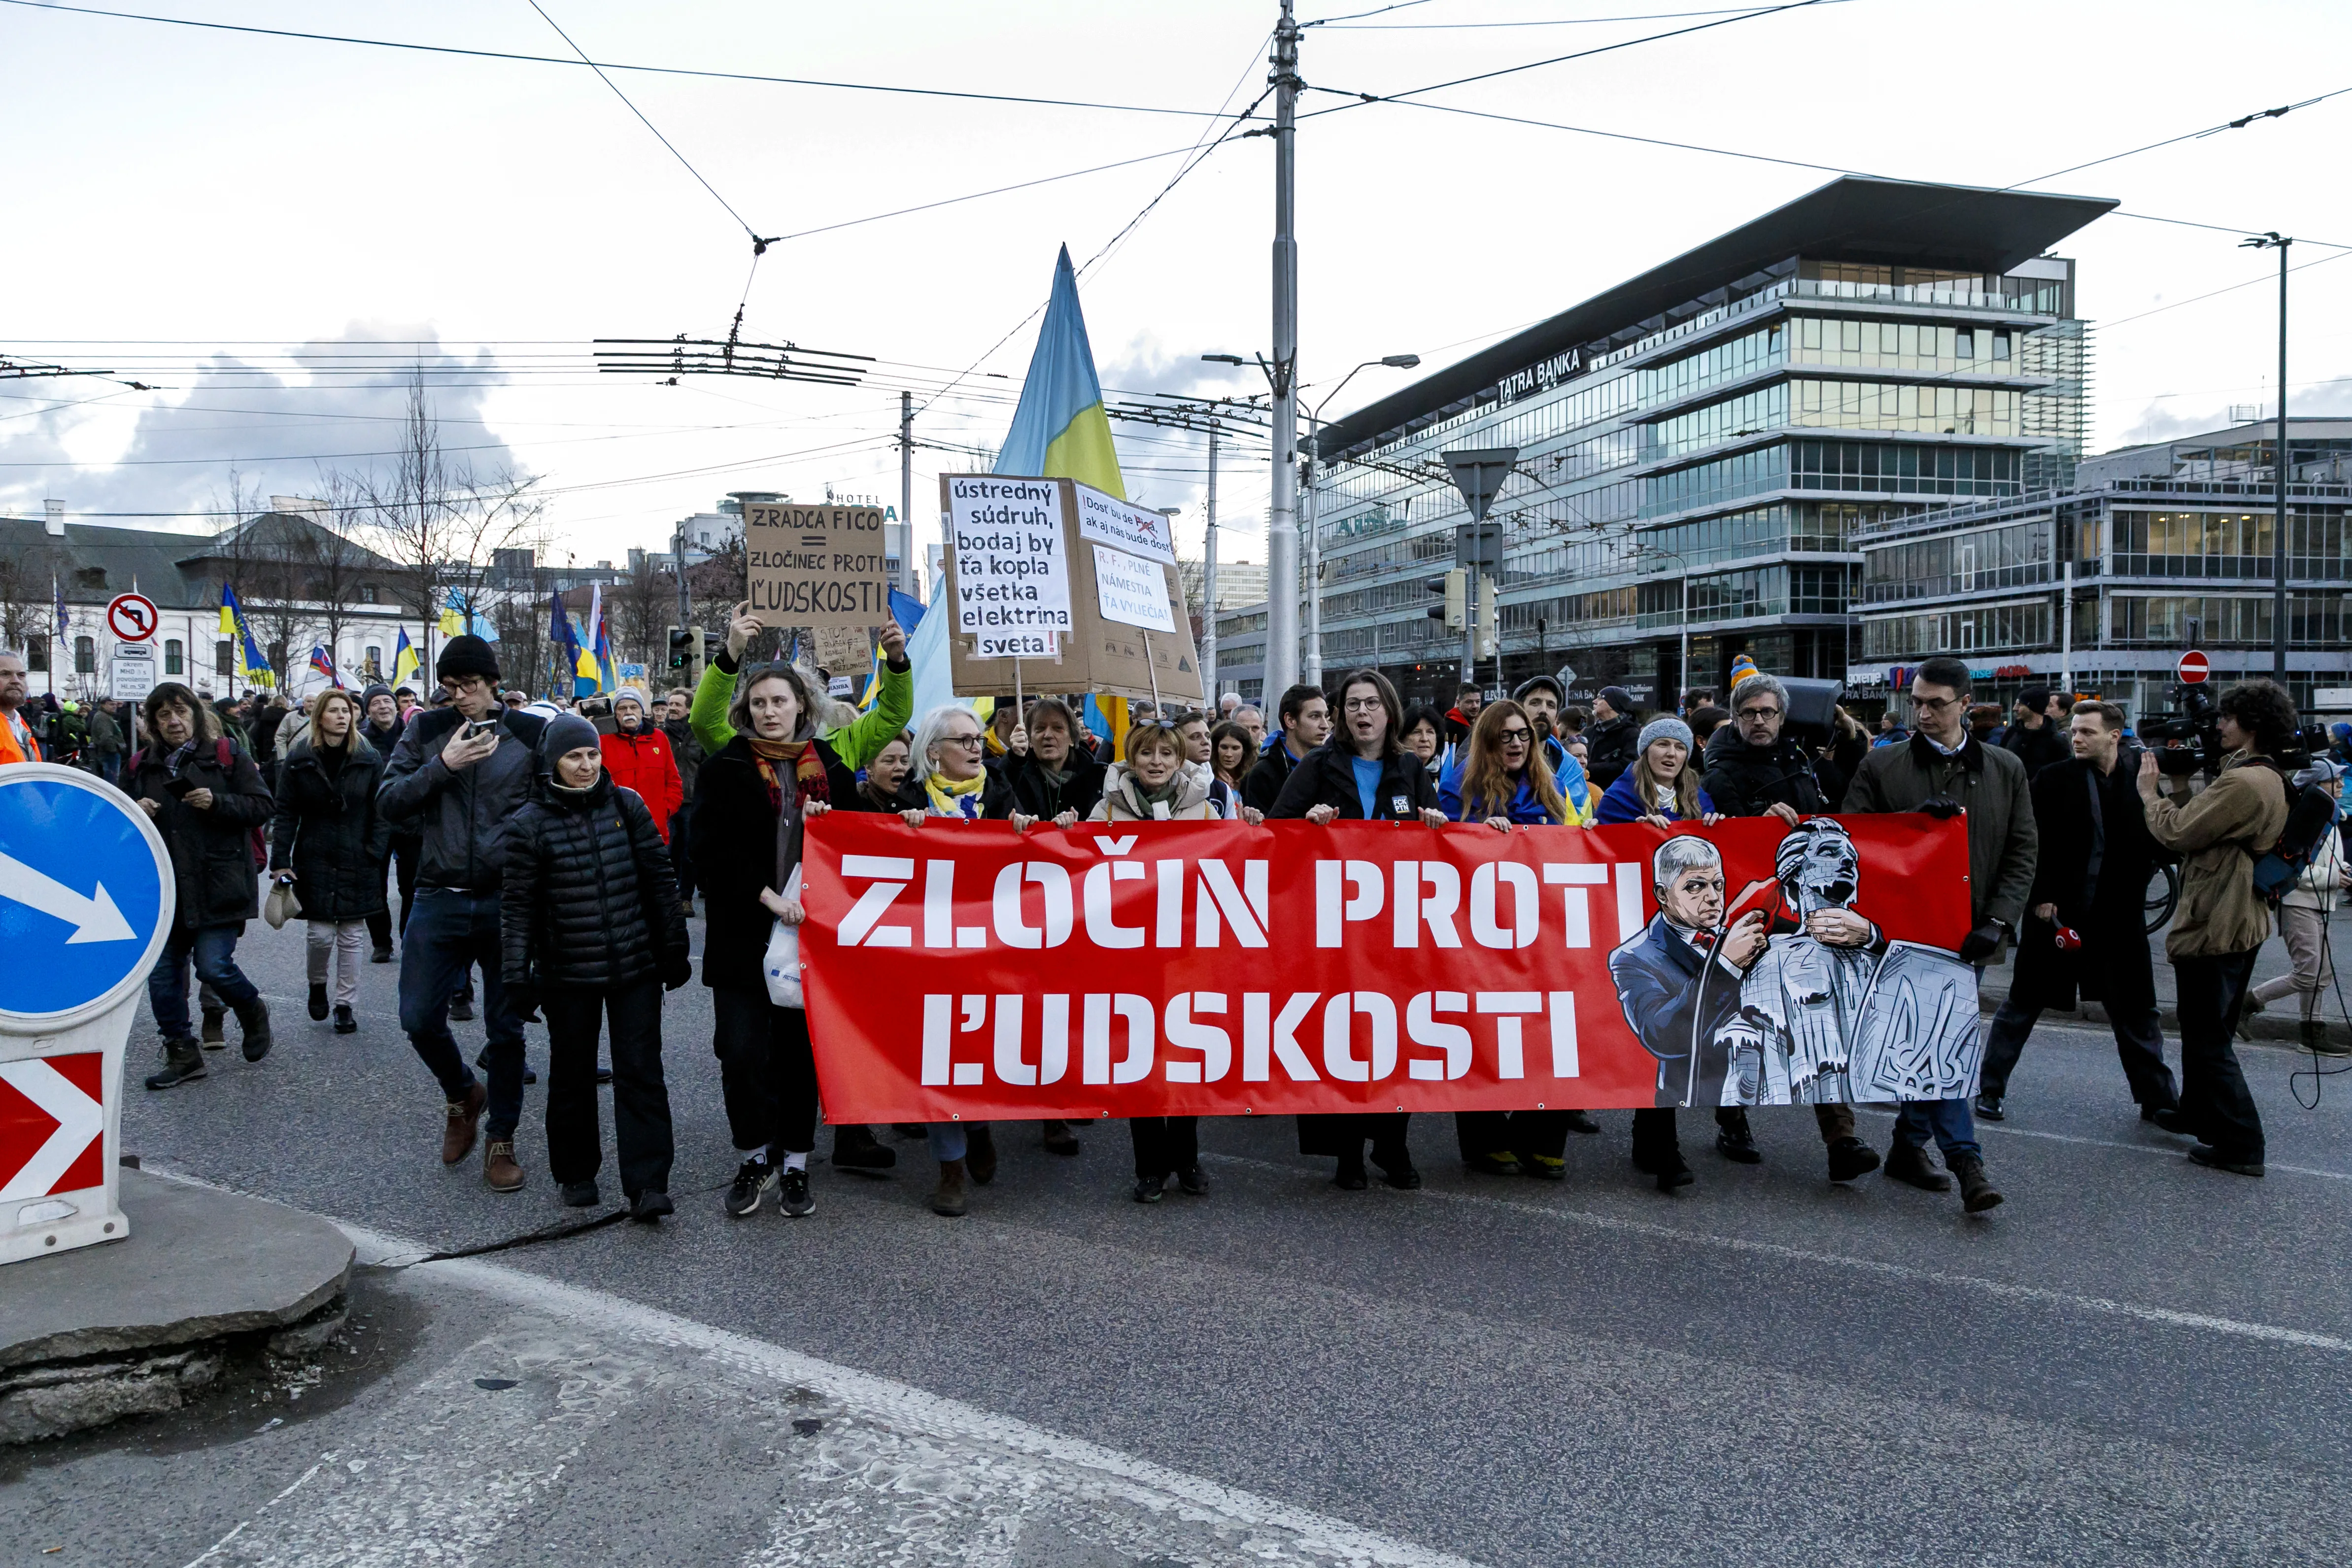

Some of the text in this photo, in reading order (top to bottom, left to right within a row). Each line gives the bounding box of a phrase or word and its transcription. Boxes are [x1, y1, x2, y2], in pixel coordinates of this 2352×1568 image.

[1499, 349, 1580, 402] TATRA BANKA
[837, 494, 881, 504] HOTEL
[954, 480, 1052, 507] ústredný
[751, 509, 826, 529] ZRADCA
[833, 511, 880, 531] FICO
[971, 504, 1053, 529] súdruh,
[1086, 516, 1098, 528] ak
[1100, 521, 1108, 534] aj
[1110, 525, 1125, 538] nás
[1125, 530, 1148, 545] bude
[957, 531, 1054, 555] bodaj by
[750, 550, 883, 572] ZLOČINEC PROTI
[959, 555, 1049, 580] ťa kopla
[1128, 559, 1151, 577] PLNÉ
[751, 579, 881, 613] ĽUDSKOSTI
[960, 581, 1038, 601] všetka
[1101, 573, 1152, 597] NÁMESTIA
[963, 605, 1068, 626] elektrina
[1103, 592, 1169, 621] ŤA VYLIEČIA!
[820, 626, 847, 640] STOP
[1847, 669, 1881, 687] gorenje
[1995, 665, 2031, 678] MORA
[2313, 724, 2321, 733] 2
[837, 835, 1645, 949] ZLOČIN PROTI
[783, 974, 801, 984] ACTION
[921, 991, 1580, 1086] ĽUDSKOSTI
